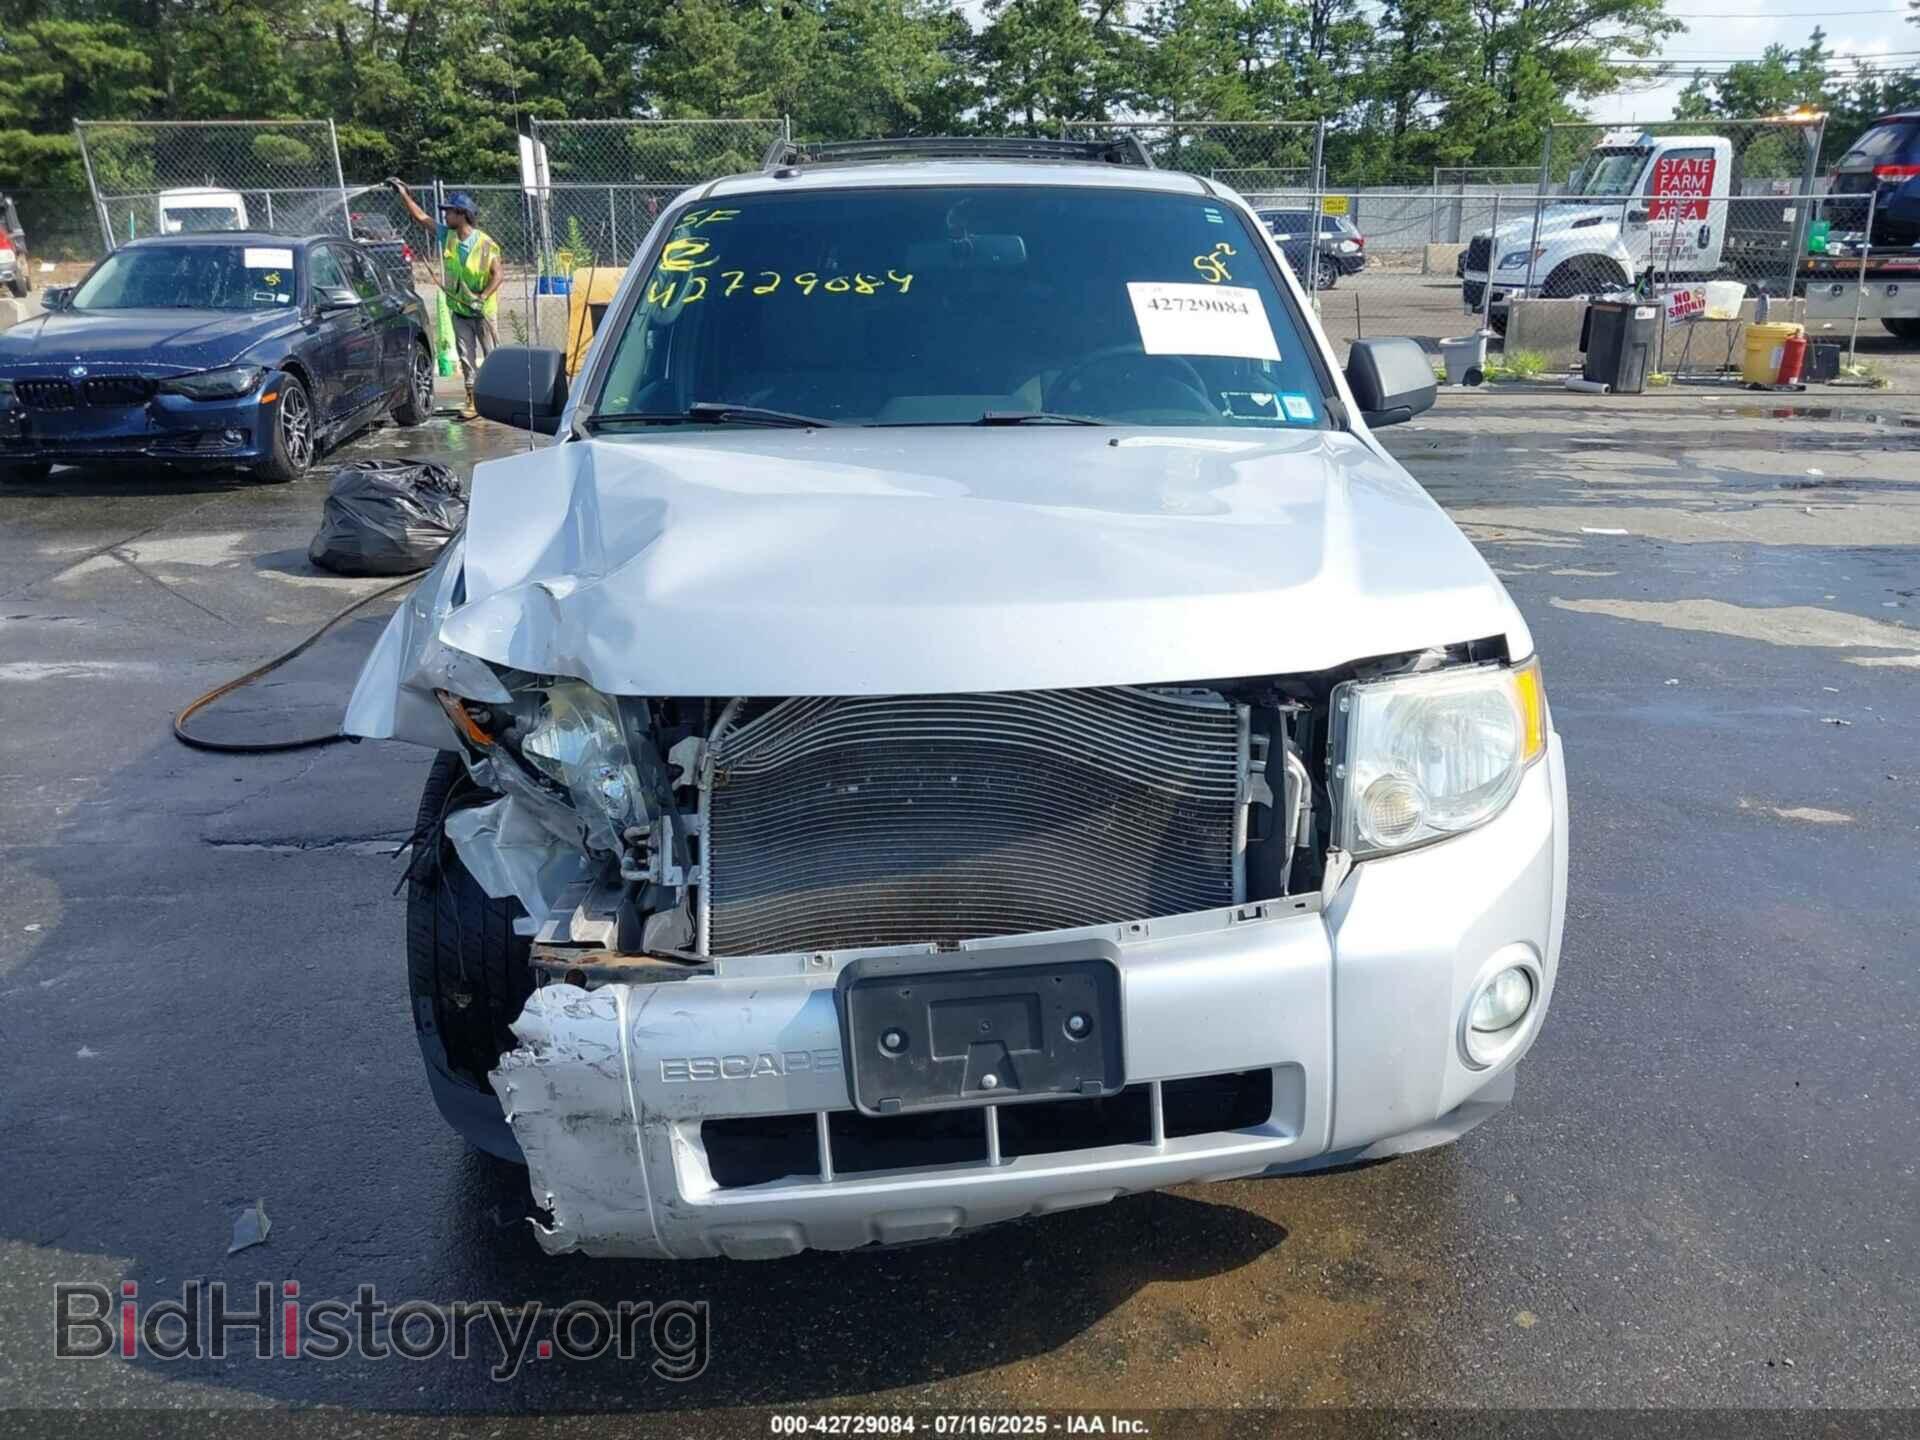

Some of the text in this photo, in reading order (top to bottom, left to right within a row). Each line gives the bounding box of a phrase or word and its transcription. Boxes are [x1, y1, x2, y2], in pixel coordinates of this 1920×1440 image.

[1660, 159, 1710, 173] STATE
[1660, 174, 1706, 189] FARM
[1658, 190, 1703, 204] DROP
[1656, 206, 1698, 220] AREA
[648, 270, 913, 308] 42729084
[1674, 291, 1690, 304] NO
[1148, 298, 1248, 315] 42729084
[660, 1048, 840, 1082] ESCAPE
